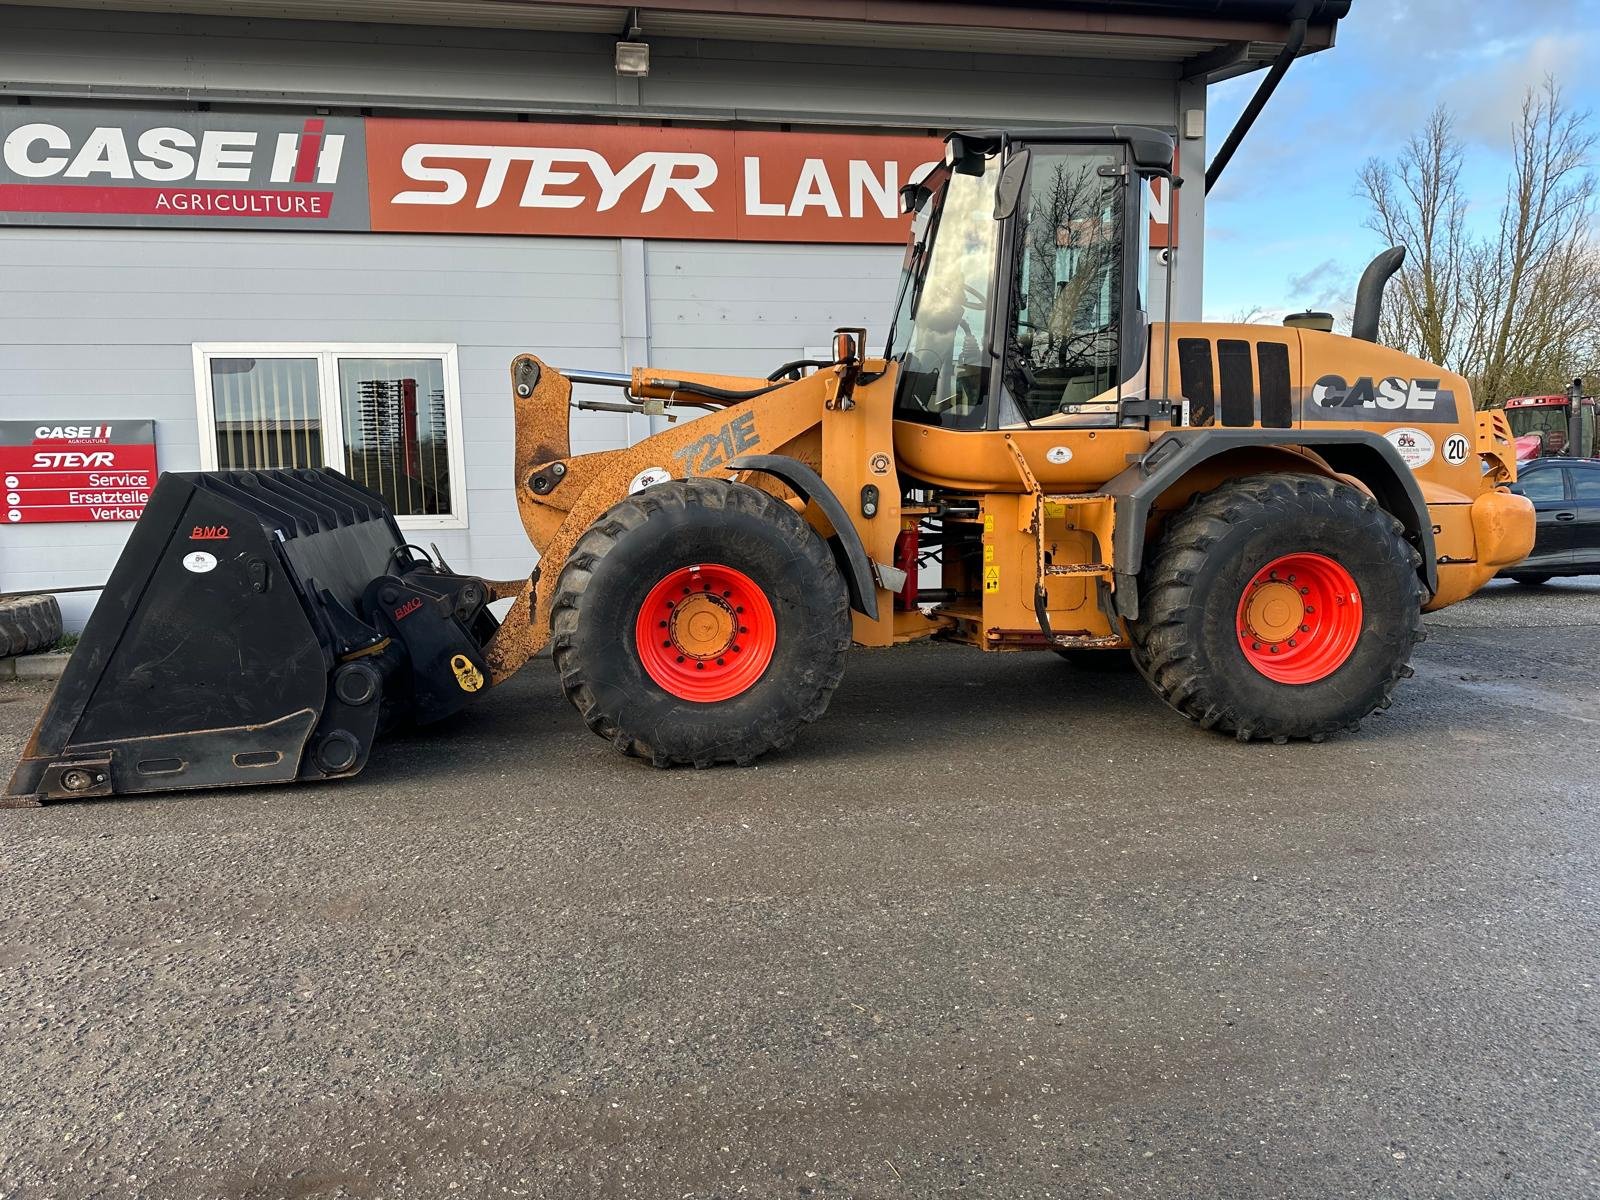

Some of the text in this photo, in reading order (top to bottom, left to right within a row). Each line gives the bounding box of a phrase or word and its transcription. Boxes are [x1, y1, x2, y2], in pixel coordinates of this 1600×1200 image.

[3, 122, 257, 182] CASE
[390, 143, 719, 214] STEYR
[155, 193, 322, 214] AGRICULTURE
[1312, 374, 1441, 410] CASE
[35, 426, 92, 439] CASE
[673, 410, 761, 477] 721E
[1448, 439, 1465, 460] 20
[32, 451, 115, 468] STEYR
[89, 473, 148, 487] Service
[69, 490, 149, 504] Ersatzteile
[90, 507, 144, 520] Verkau
[191, 525, 229, 539] BMO
[394, 597, 423, 621] BMO
